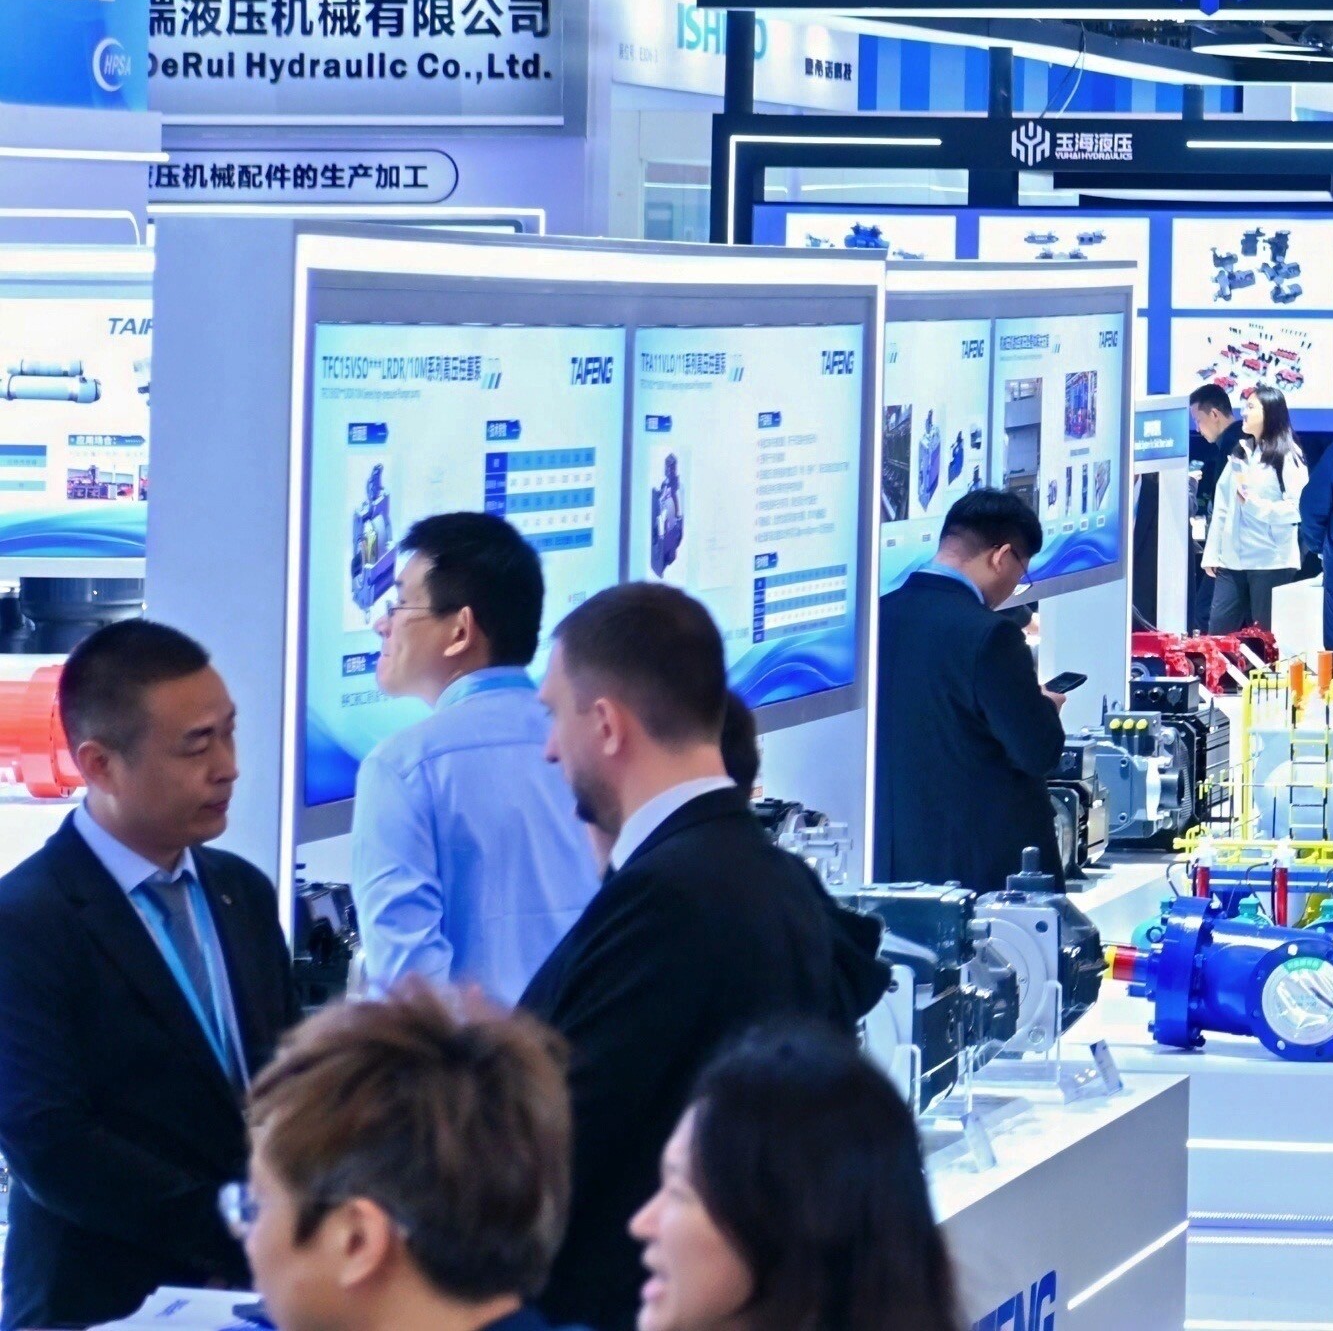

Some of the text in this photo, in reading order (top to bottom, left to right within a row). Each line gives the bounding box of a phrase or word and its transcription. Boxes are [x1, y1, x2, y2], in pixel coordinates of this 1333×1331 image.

[104, 54, 132, 76] HPSA
[246, 52, 407, 84] Hydraulic
[417, 52, 552, 85] Co.,Ltd.
[1055, 133, 1133, 153] 玉海液压
[1055, 152, 1133, 161] YUHAI HYDRAULICS
[570, 356, 614, 385] TAIFENG
